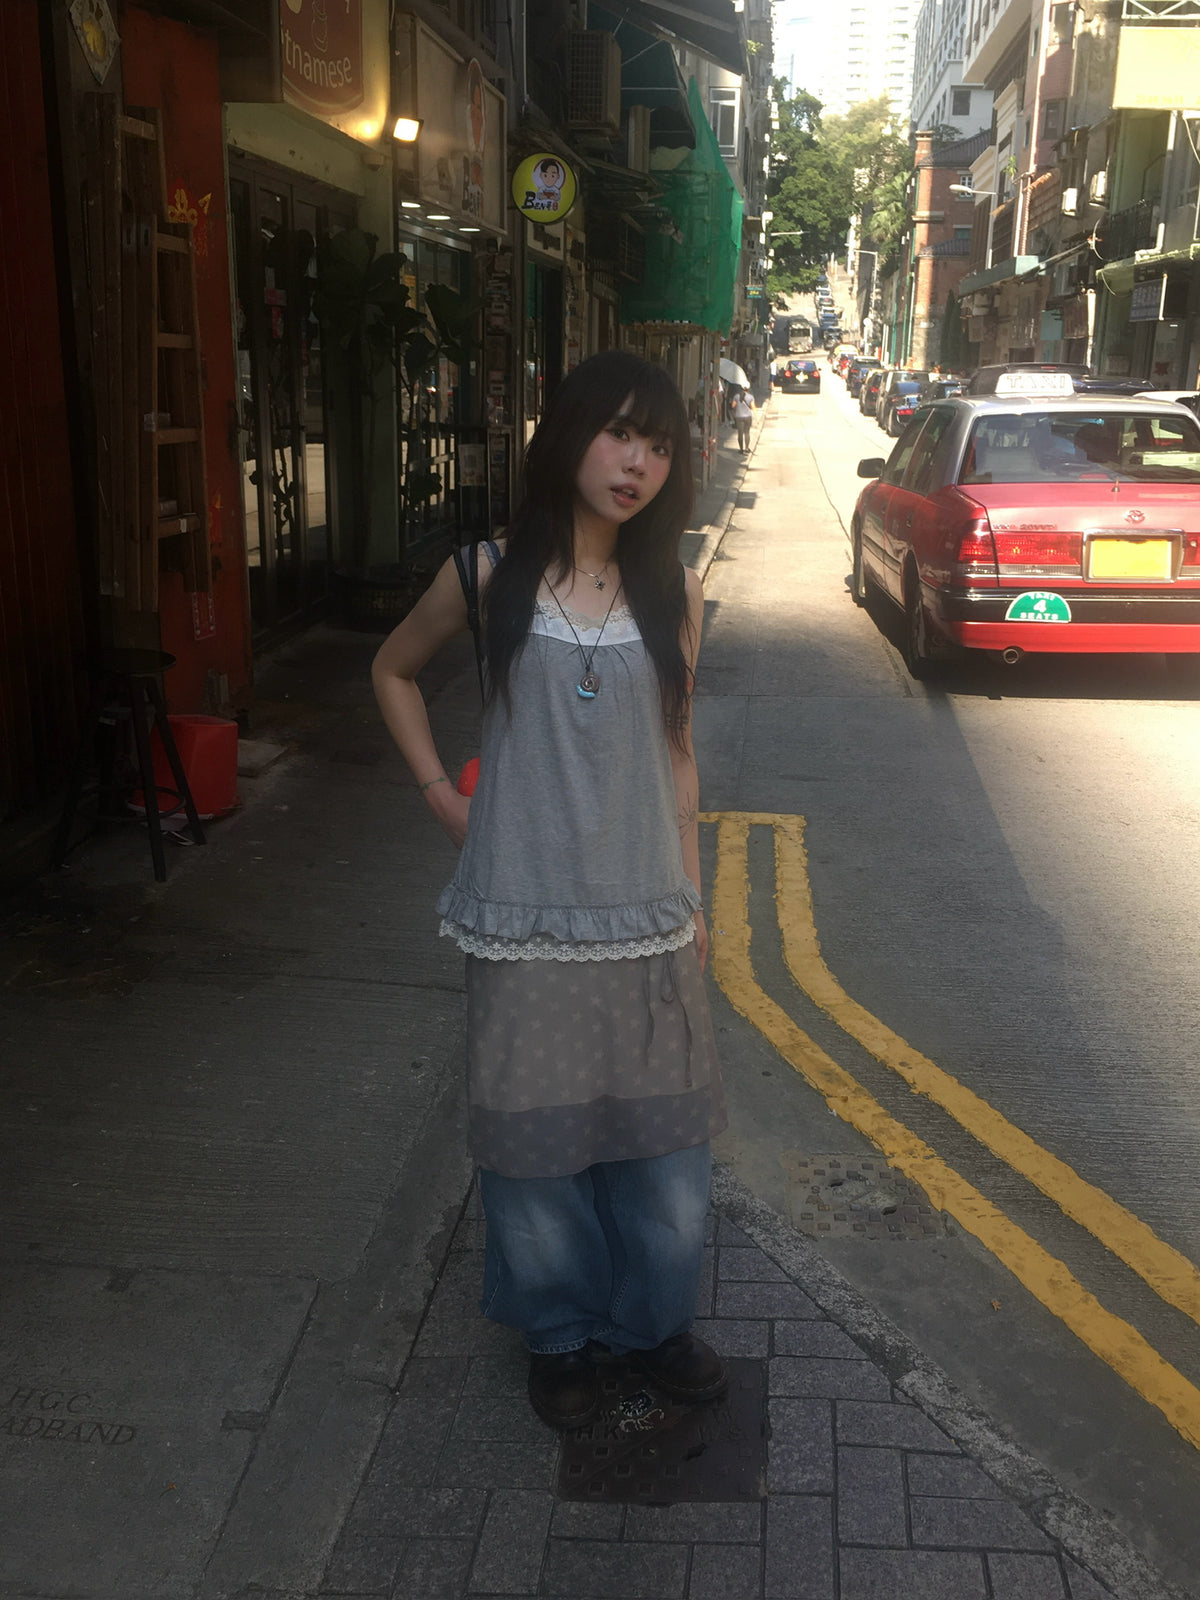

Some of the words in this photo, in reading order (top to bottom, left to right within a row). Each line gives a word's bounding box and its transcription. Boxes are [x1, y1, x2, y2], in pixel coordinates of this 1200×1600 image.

[281, 28, 353, 89] tnamese
[1006, 375, 1066, 389] TAXI
[1033, 599, 1047, 613] 4
[1019, 612, 1059, 620] SEATS
[7, 1386, 93, 1413] HGC
